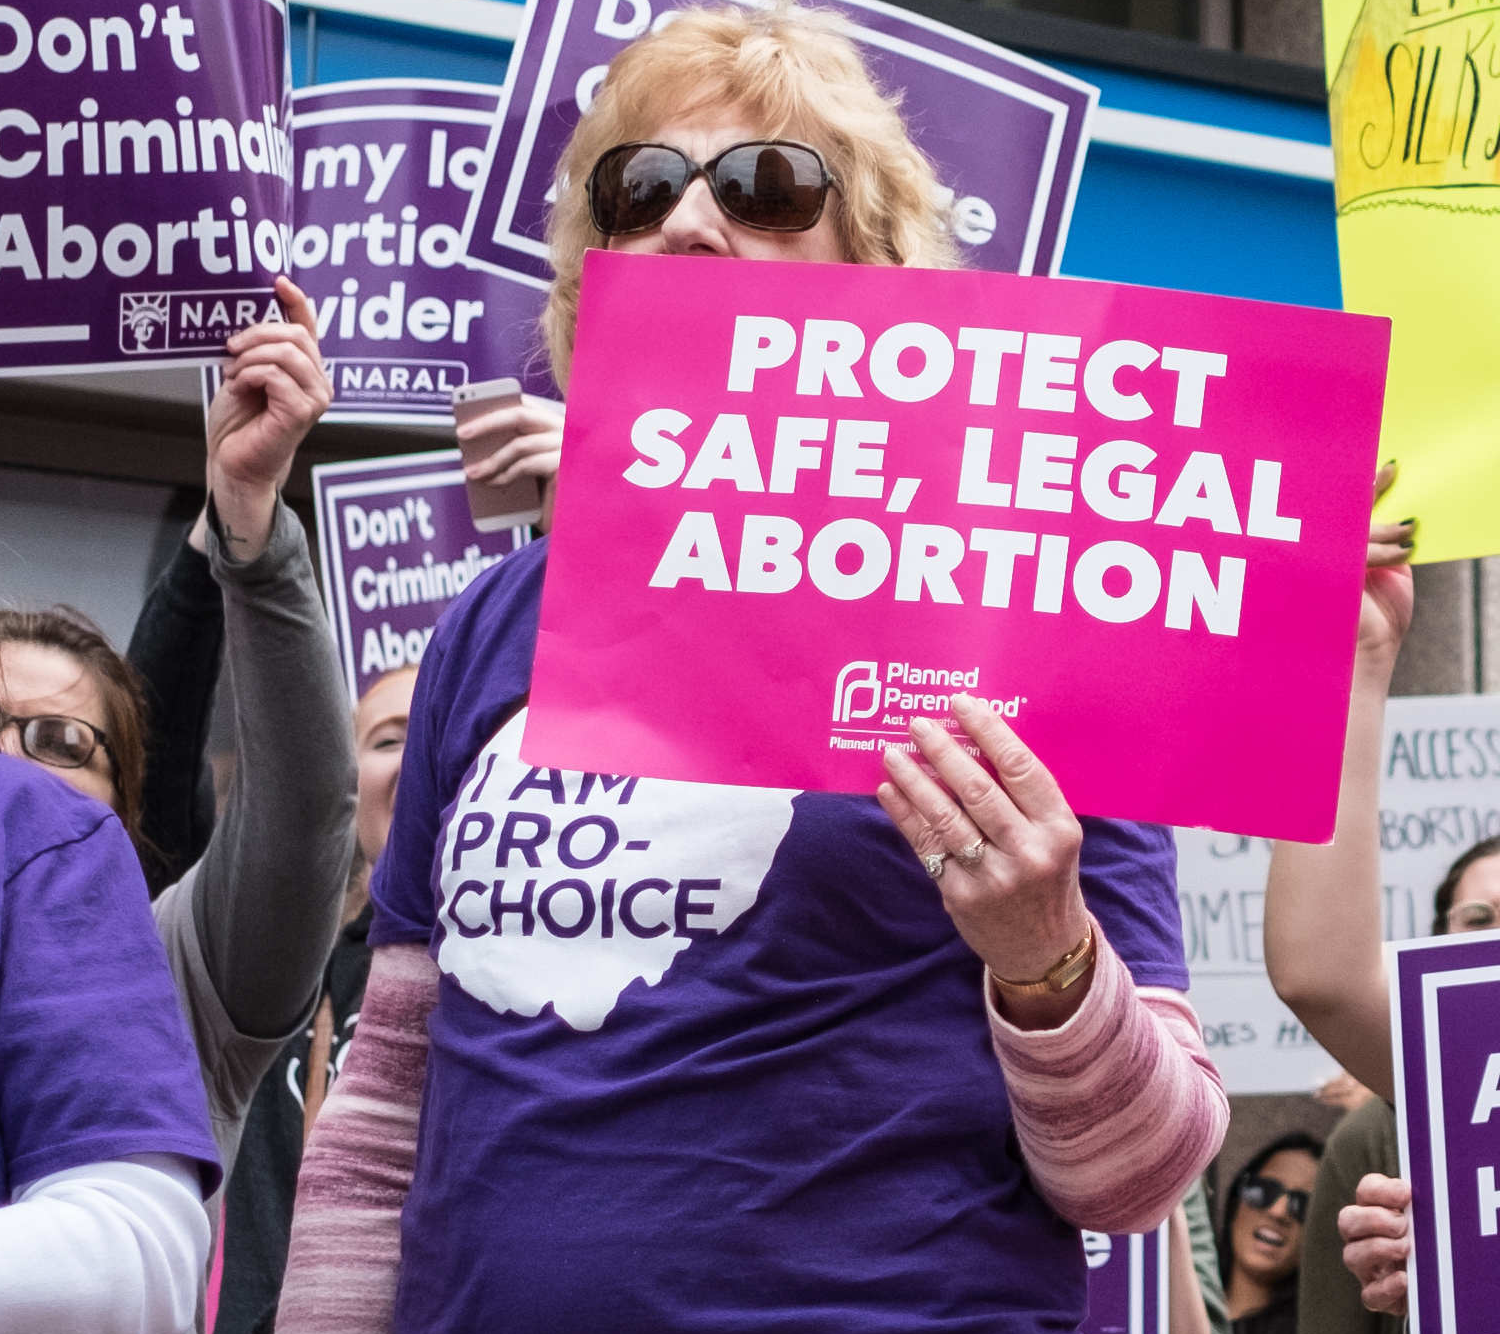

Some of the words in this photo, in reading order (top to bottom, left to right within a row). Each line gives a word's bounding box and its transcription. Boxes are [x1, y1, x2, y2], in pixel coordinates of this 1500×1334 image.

[301, 143, 407, 203] my
[181, 299, 290, 328] NARA
[341, 366, 454, 391] NARAL
[727, 314, 1227, 428] PROTECT
[622, 408, 922, 513] SAFE,
[957, 427, 1302, 543] LEGAL
[344, 497, 435, 550] Don't
[648, 511, 1246, 638] ABORTION
[887, 662, 980, 688] Planned
[829, 736, 875, 751] Planned
[469, 753, 498, 803] I
[508, 766, 640, 805] AM
[452, 811, 651, 871] PRO-
[448, 878, 722, 939] CHOICE
